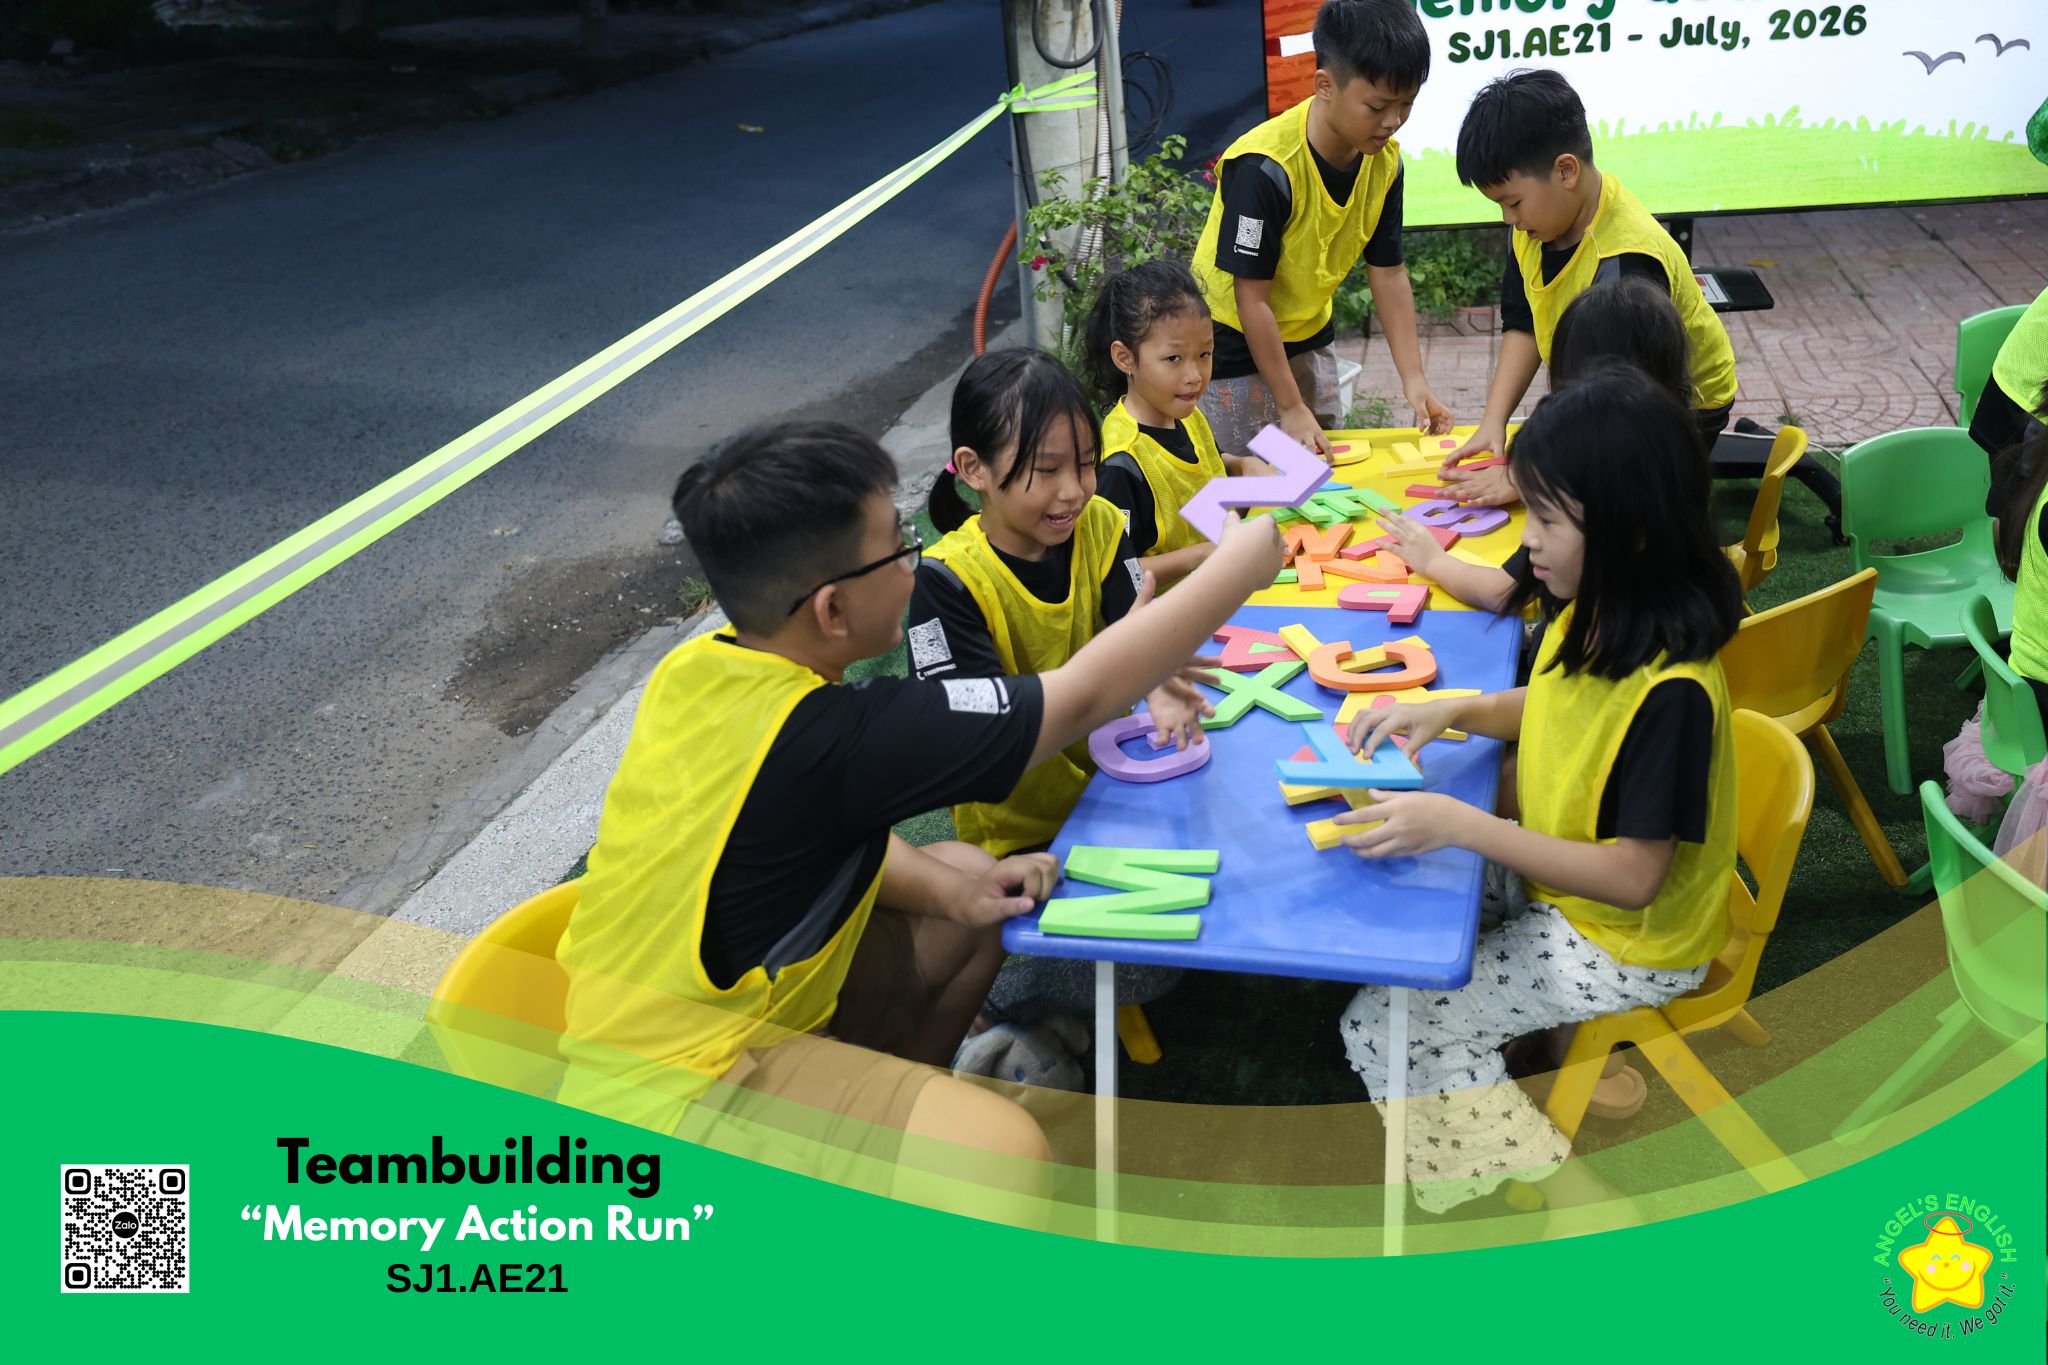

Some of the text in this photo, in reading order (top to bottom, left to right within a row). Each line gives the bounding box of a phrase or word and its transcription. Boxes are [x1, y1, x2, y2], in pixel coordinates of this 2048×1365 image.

[1447, 22, 1612, 63] SJ1.AE21
[1660, 16, 1750, 51] July,
[1769, 5, 1867, 40] 2026
